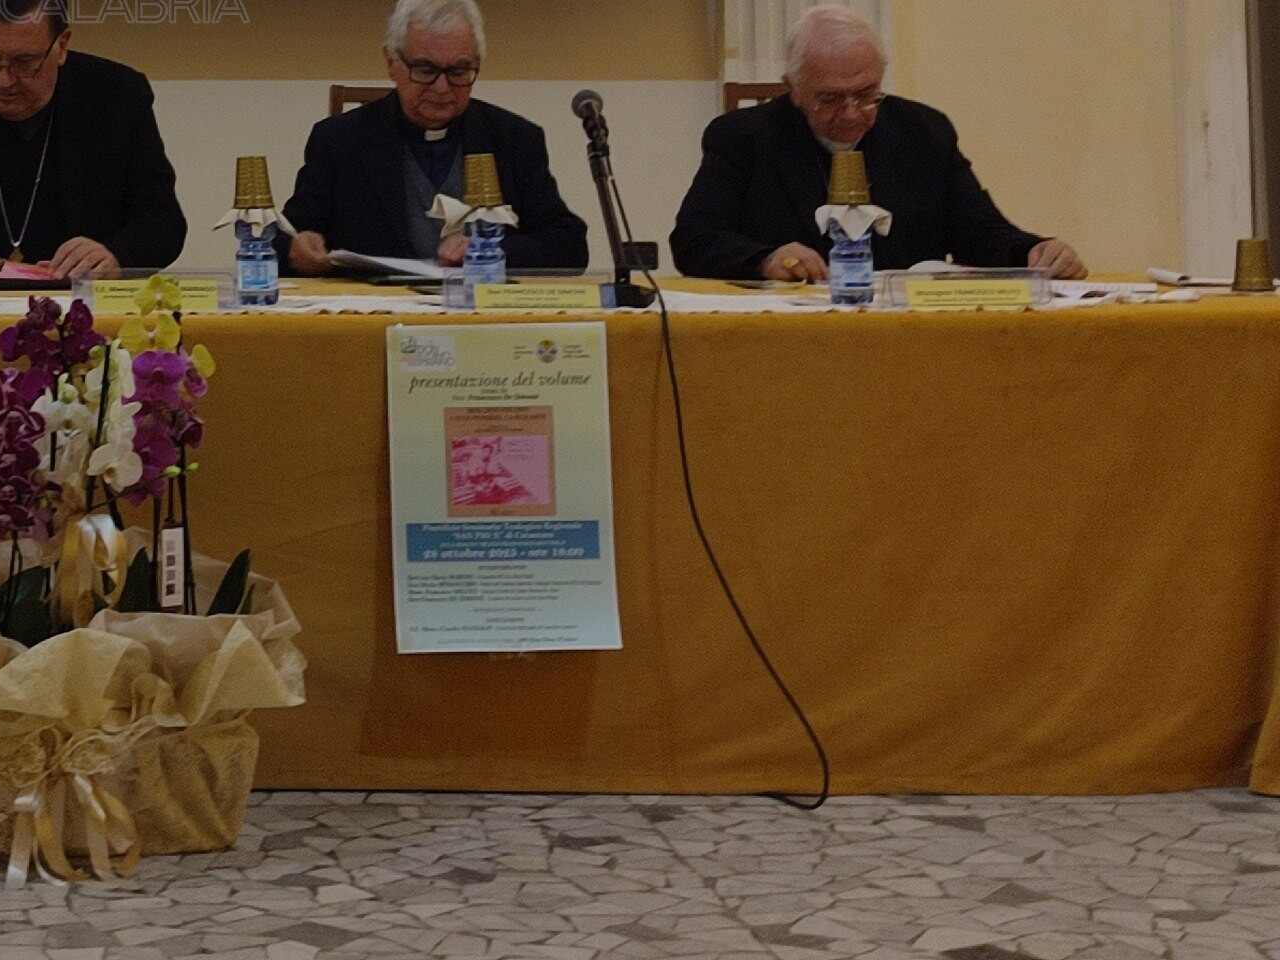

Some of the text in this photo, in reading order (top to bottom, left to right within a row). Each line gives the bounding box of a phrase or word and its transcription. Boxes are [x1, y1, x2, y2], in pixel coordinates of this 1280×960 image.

[408, 370, 592, 394] presentazione del volume
